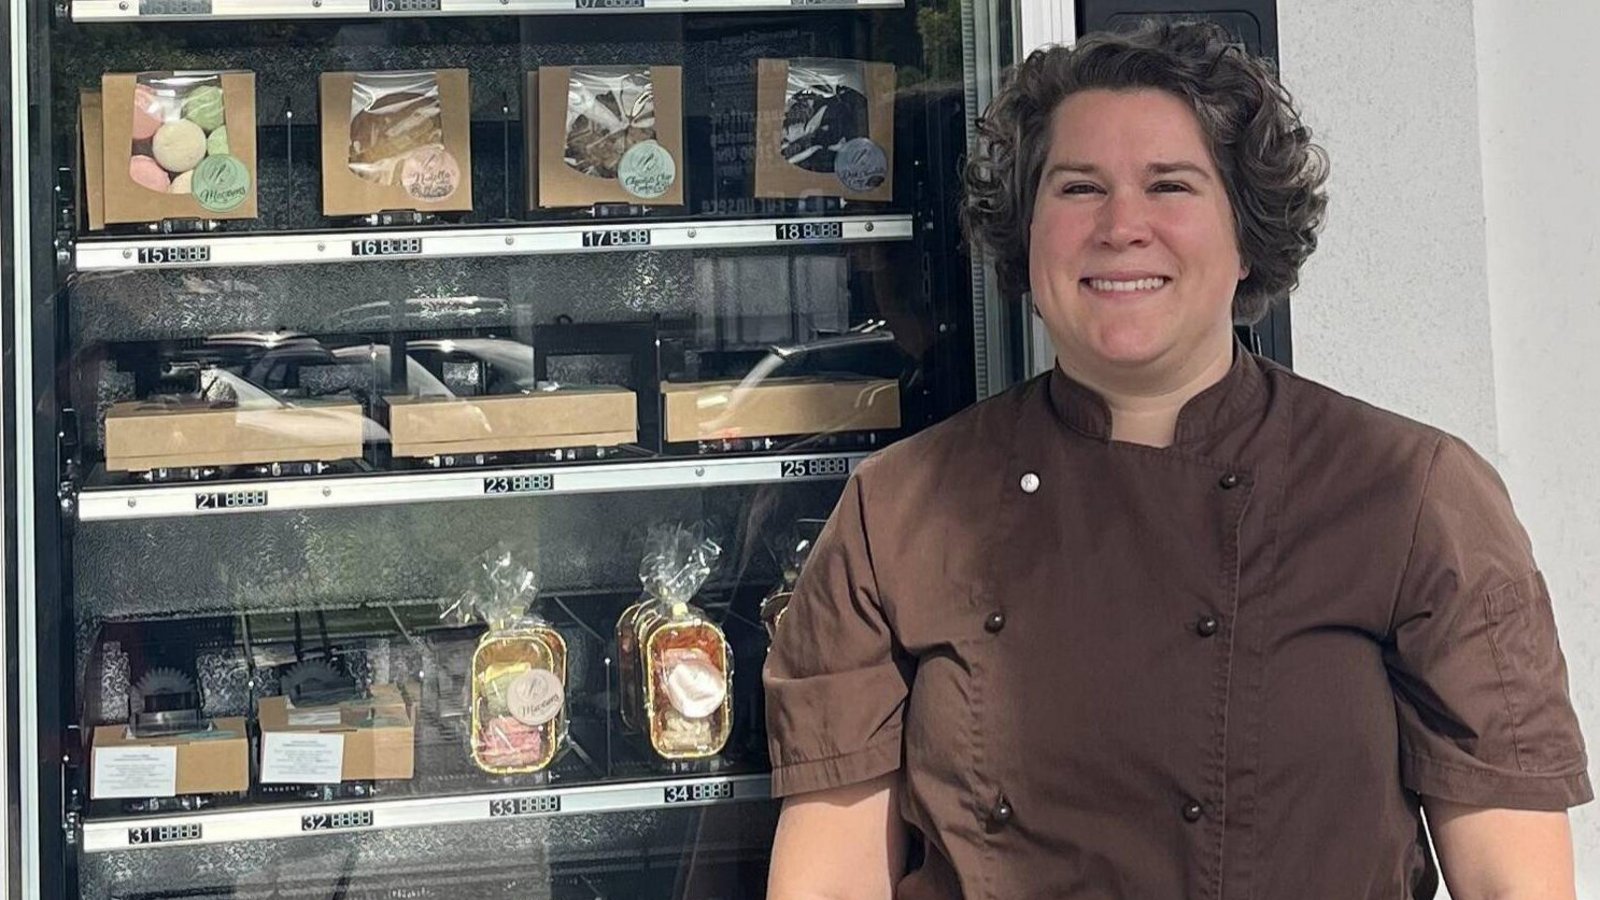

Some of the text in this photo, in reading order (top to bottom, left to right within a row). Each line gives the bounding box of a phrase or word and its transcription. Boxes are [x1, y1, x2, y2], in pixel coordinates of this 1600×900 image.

[585, 231, 609, 247] 17
[779, 225, 800, 240] 18
[141, 247, 164, 264] 15
[354, 239, 377, 256] 16
[784, 460, 806, 476] 25
[486, 476, 509, 493] 23
[197, 493, 220, 509] 21
[667, 787, 689, 802] 34
[492, 799, 515, 816] 33
[303, 815, 328, 831] 32
[130, 827, 153, 844] 31
